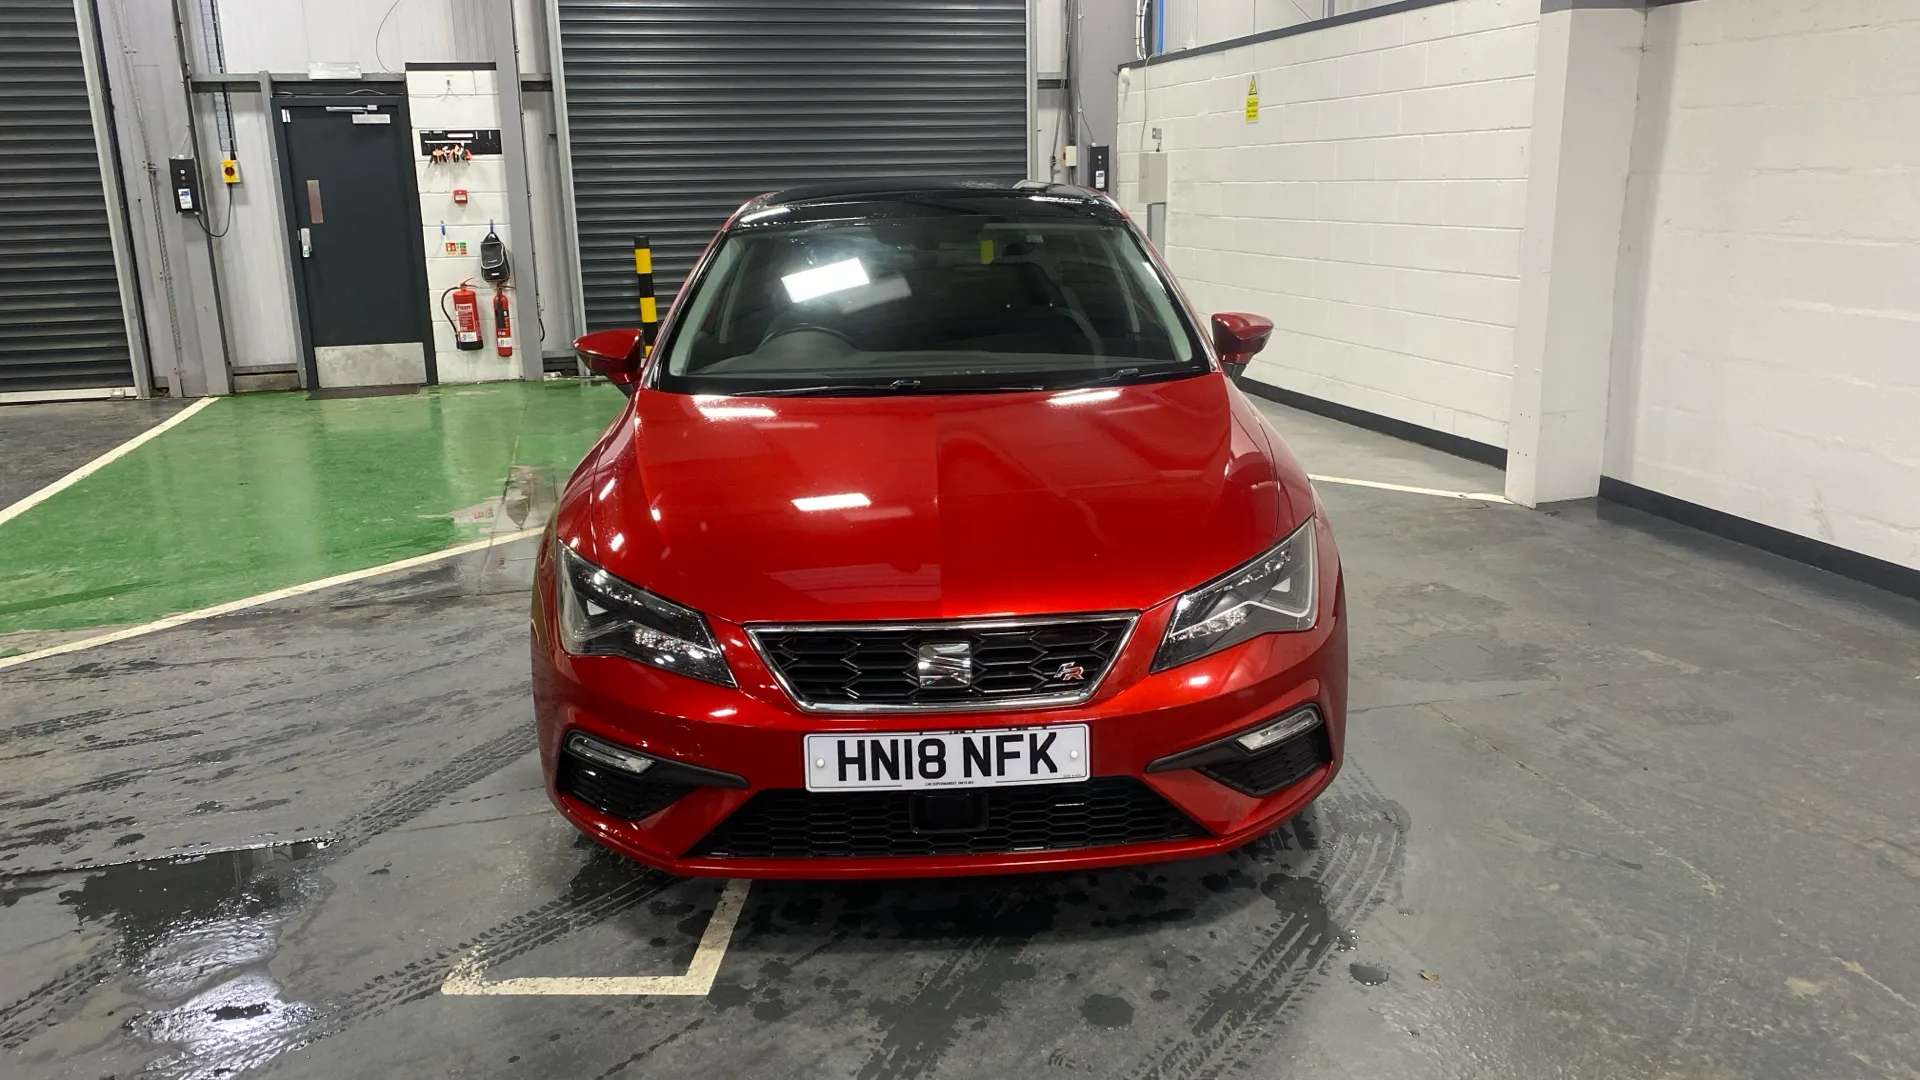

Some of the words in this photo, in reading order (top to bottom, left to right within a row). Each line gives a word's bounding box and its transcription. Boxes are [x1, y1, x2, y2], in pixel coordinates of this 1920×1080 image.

[1053, 661, 1085, 681] FR
[837, 738, 947, 781] HN18
[962, 732, 1058, 777] NFK
